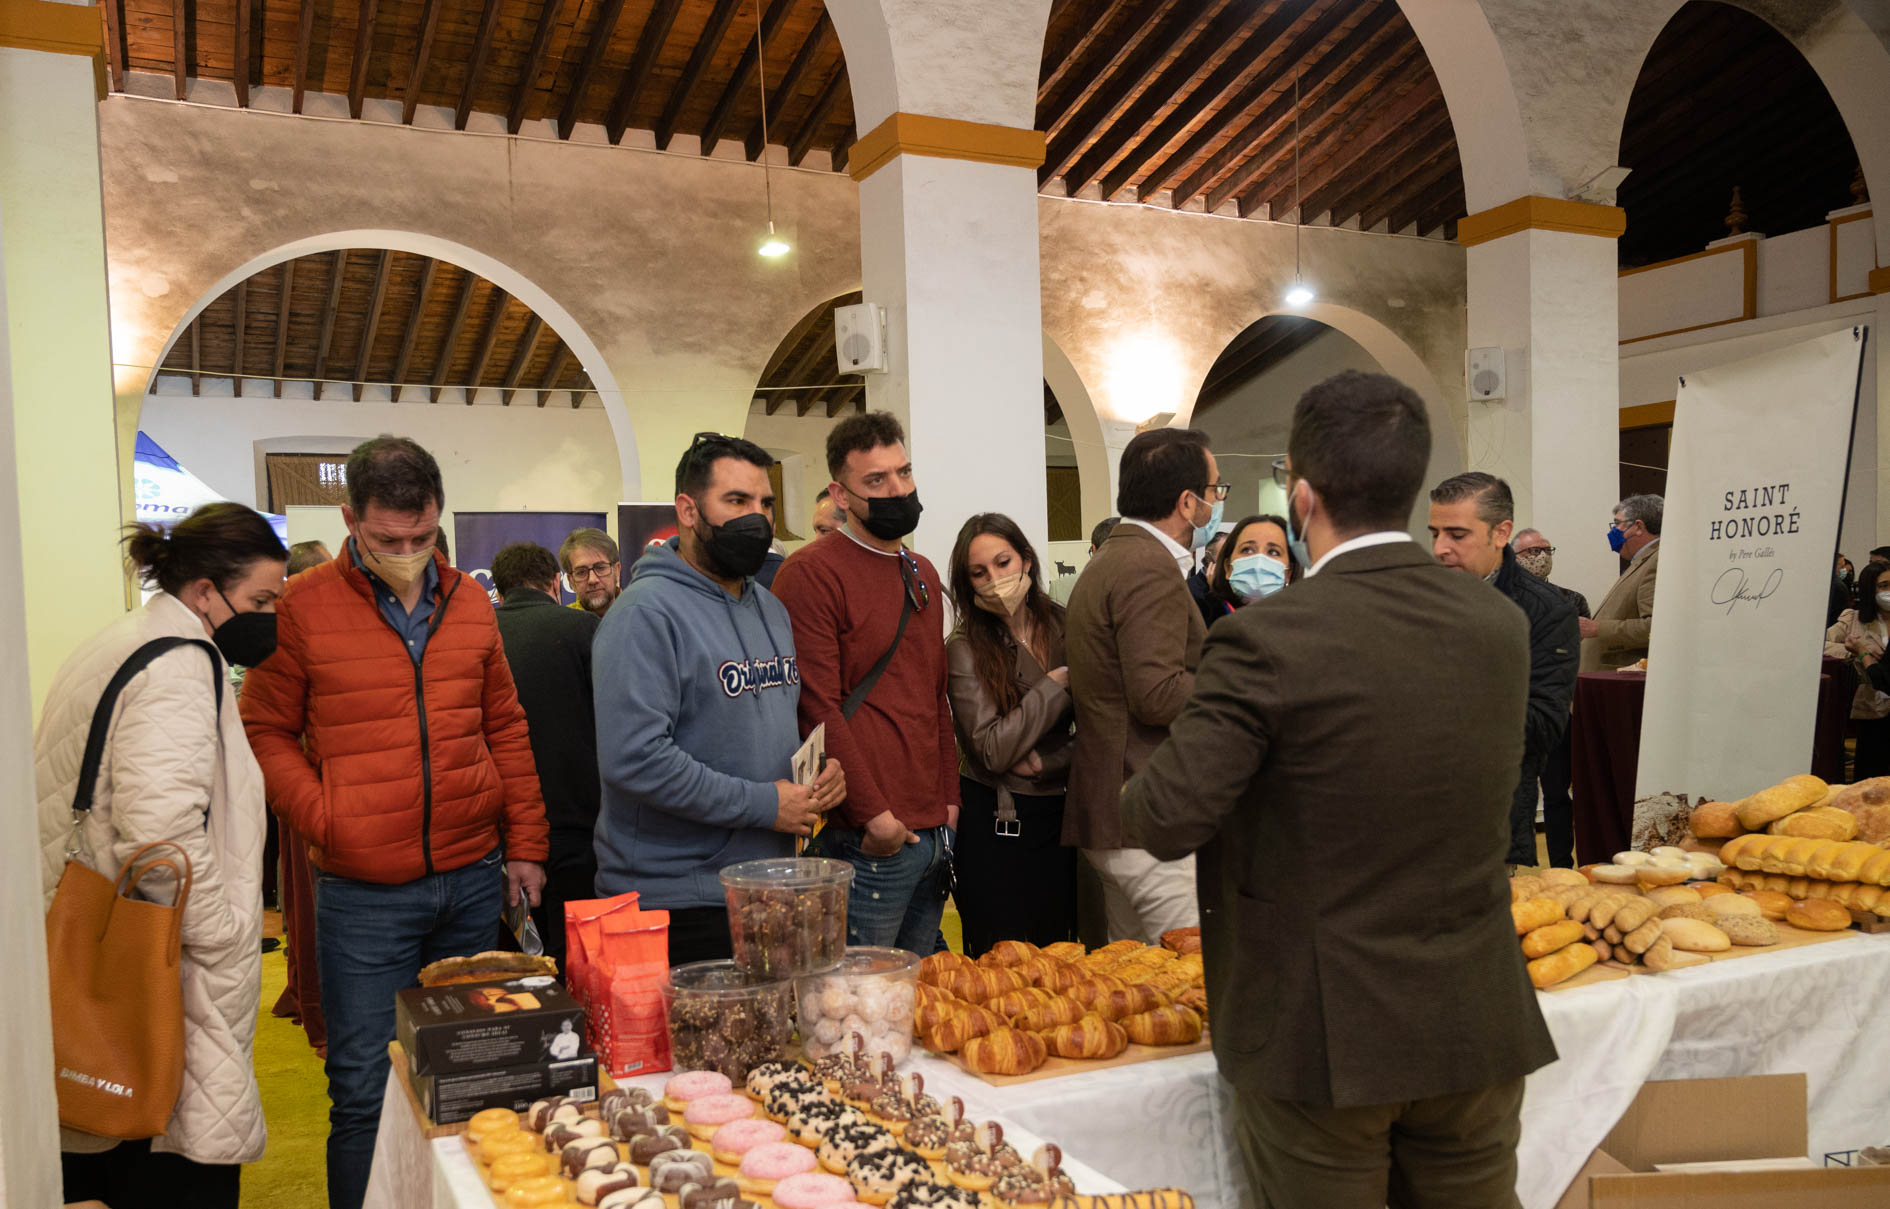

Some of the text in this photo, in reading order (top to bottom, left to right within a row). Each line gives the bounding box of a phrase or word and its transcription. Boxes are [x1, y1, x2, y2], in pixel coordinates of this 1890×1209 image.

[1724, 483, 1790, 511] SAINT
[1709, 506, 1801, 540] HONORÉ
[1728, 549, 1737, 562] by
[1738, 549, 1753, 560] Pere
[718, 655, 783, 699] Oriinal
[60, 1067, 134, 1098] BIMBA Y LOLA
